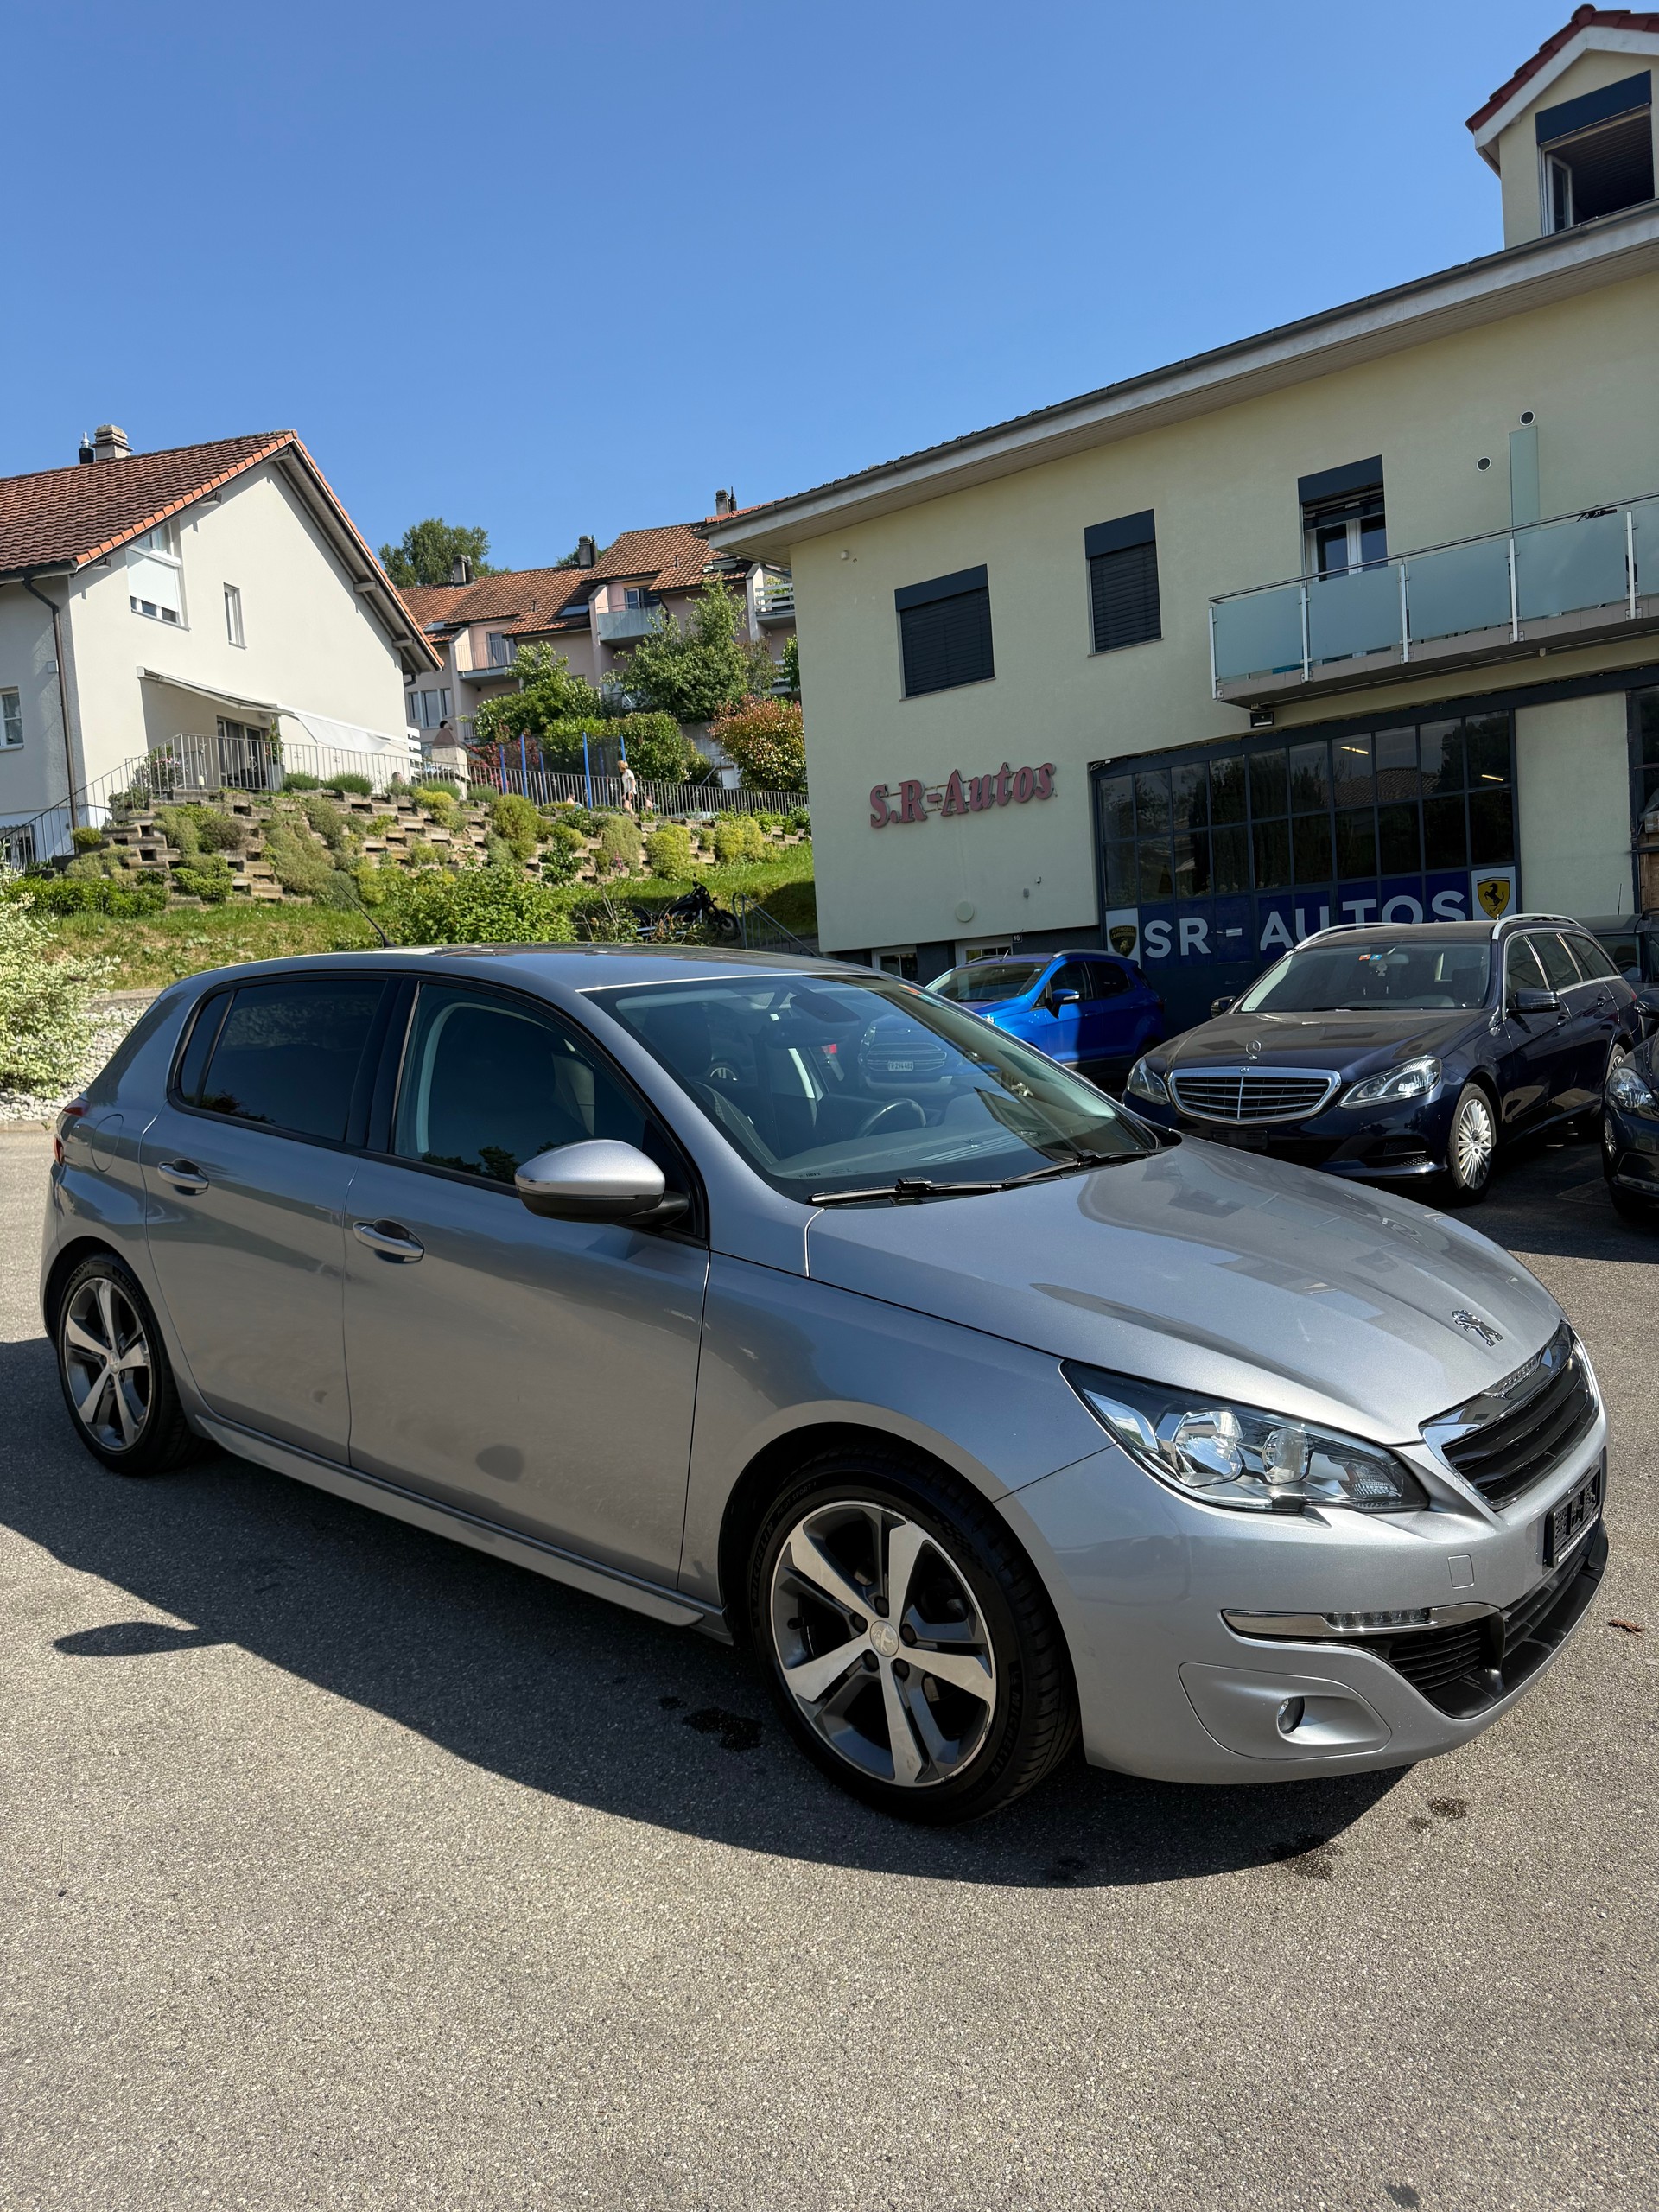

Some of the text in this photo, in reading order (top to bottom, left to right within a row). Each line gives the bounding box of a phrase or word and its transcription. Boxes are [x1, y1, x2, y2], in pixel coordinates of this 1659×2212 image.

[869, 762, 1056, 828] S.R-Autos
[1144, 917, 1211, 958] SR
[1260, 890, 1466, 951] AUTOS
[776, 1498, 791, 1517] PILOT
[791, 1483, 811, 1501] SPORT
[751, 1522, 774, 1603] MICHELIN
[990, 1691, 1021, 1777] MICHELIN
